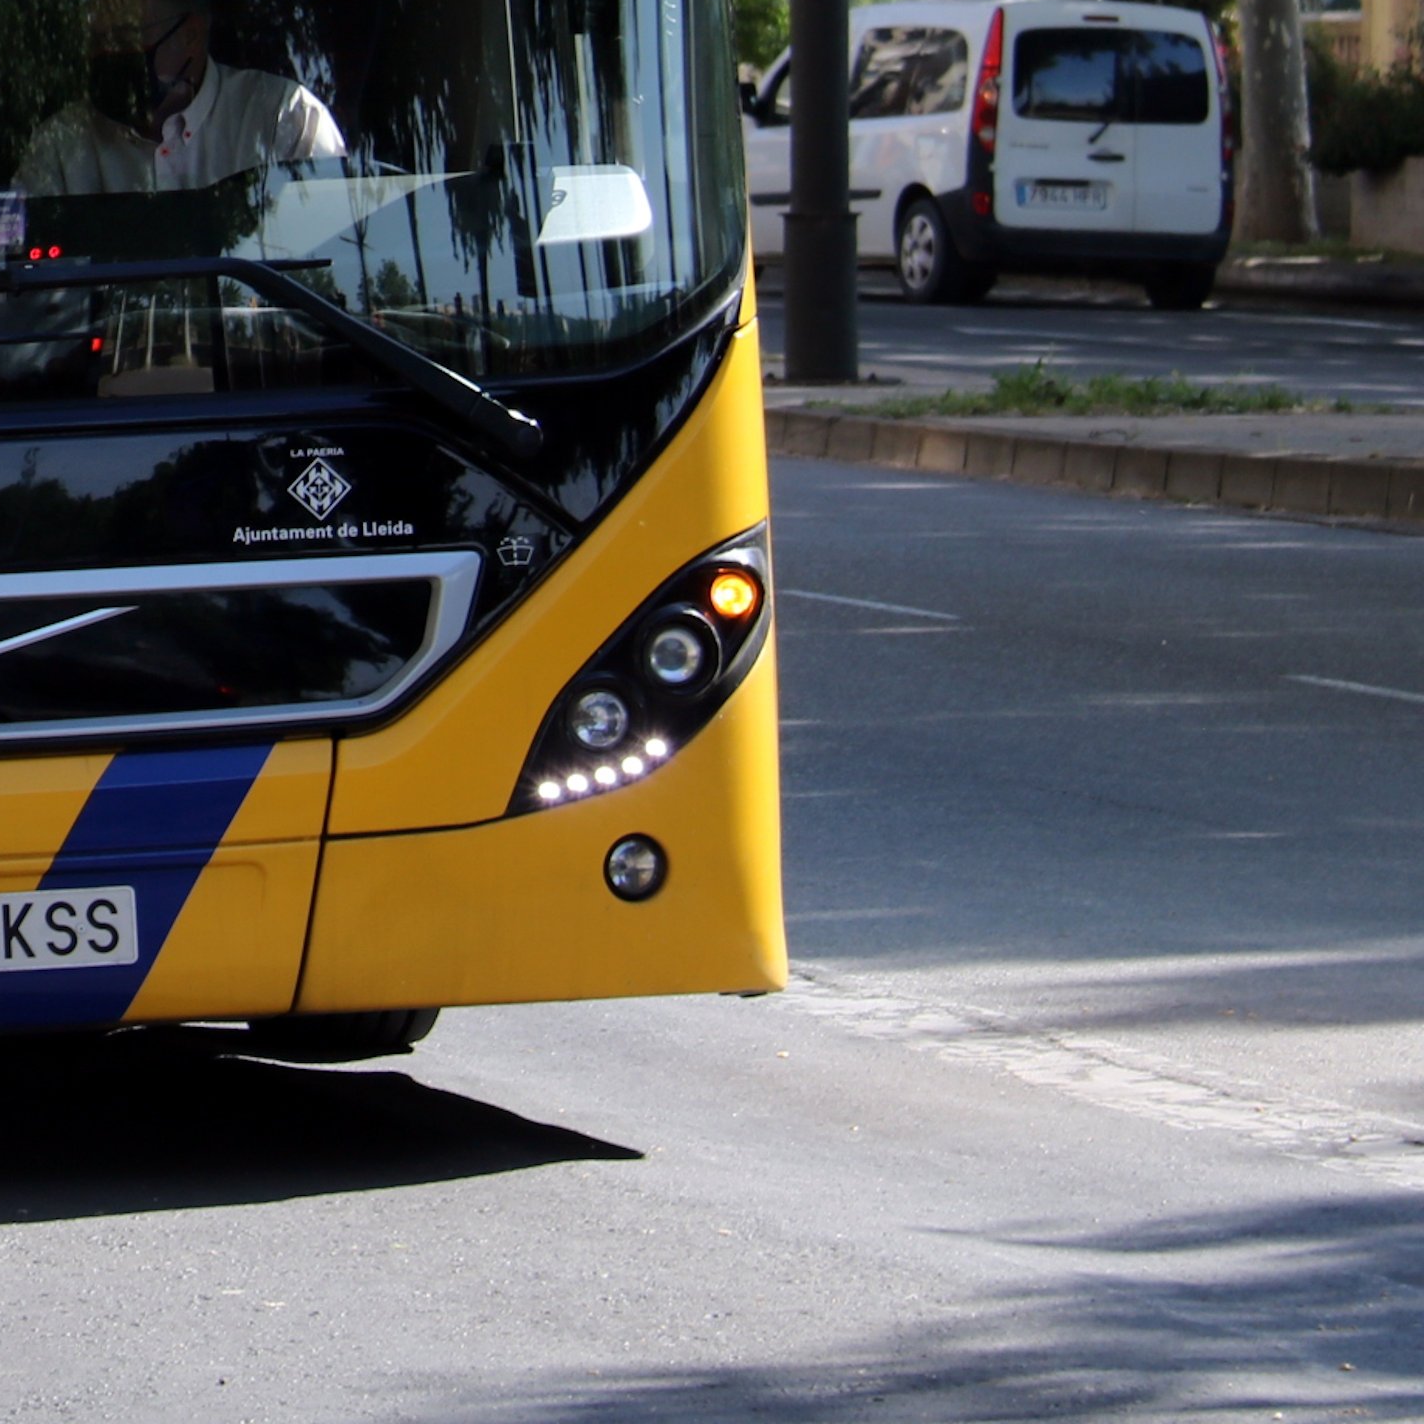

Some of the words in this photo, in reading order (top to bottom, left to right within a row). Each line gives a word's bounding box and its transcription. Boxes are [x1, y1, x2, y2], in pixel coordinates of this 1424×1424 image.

[289, 449, 305, 458] LA
[307, 447, 345, 457] PAERIA
[233, 522, 332, 546] Ajuntament
[337, 522, 359, 539] de
[362, 519, 414, 538] Lleida
[1, 898, 122, 960] KSS
